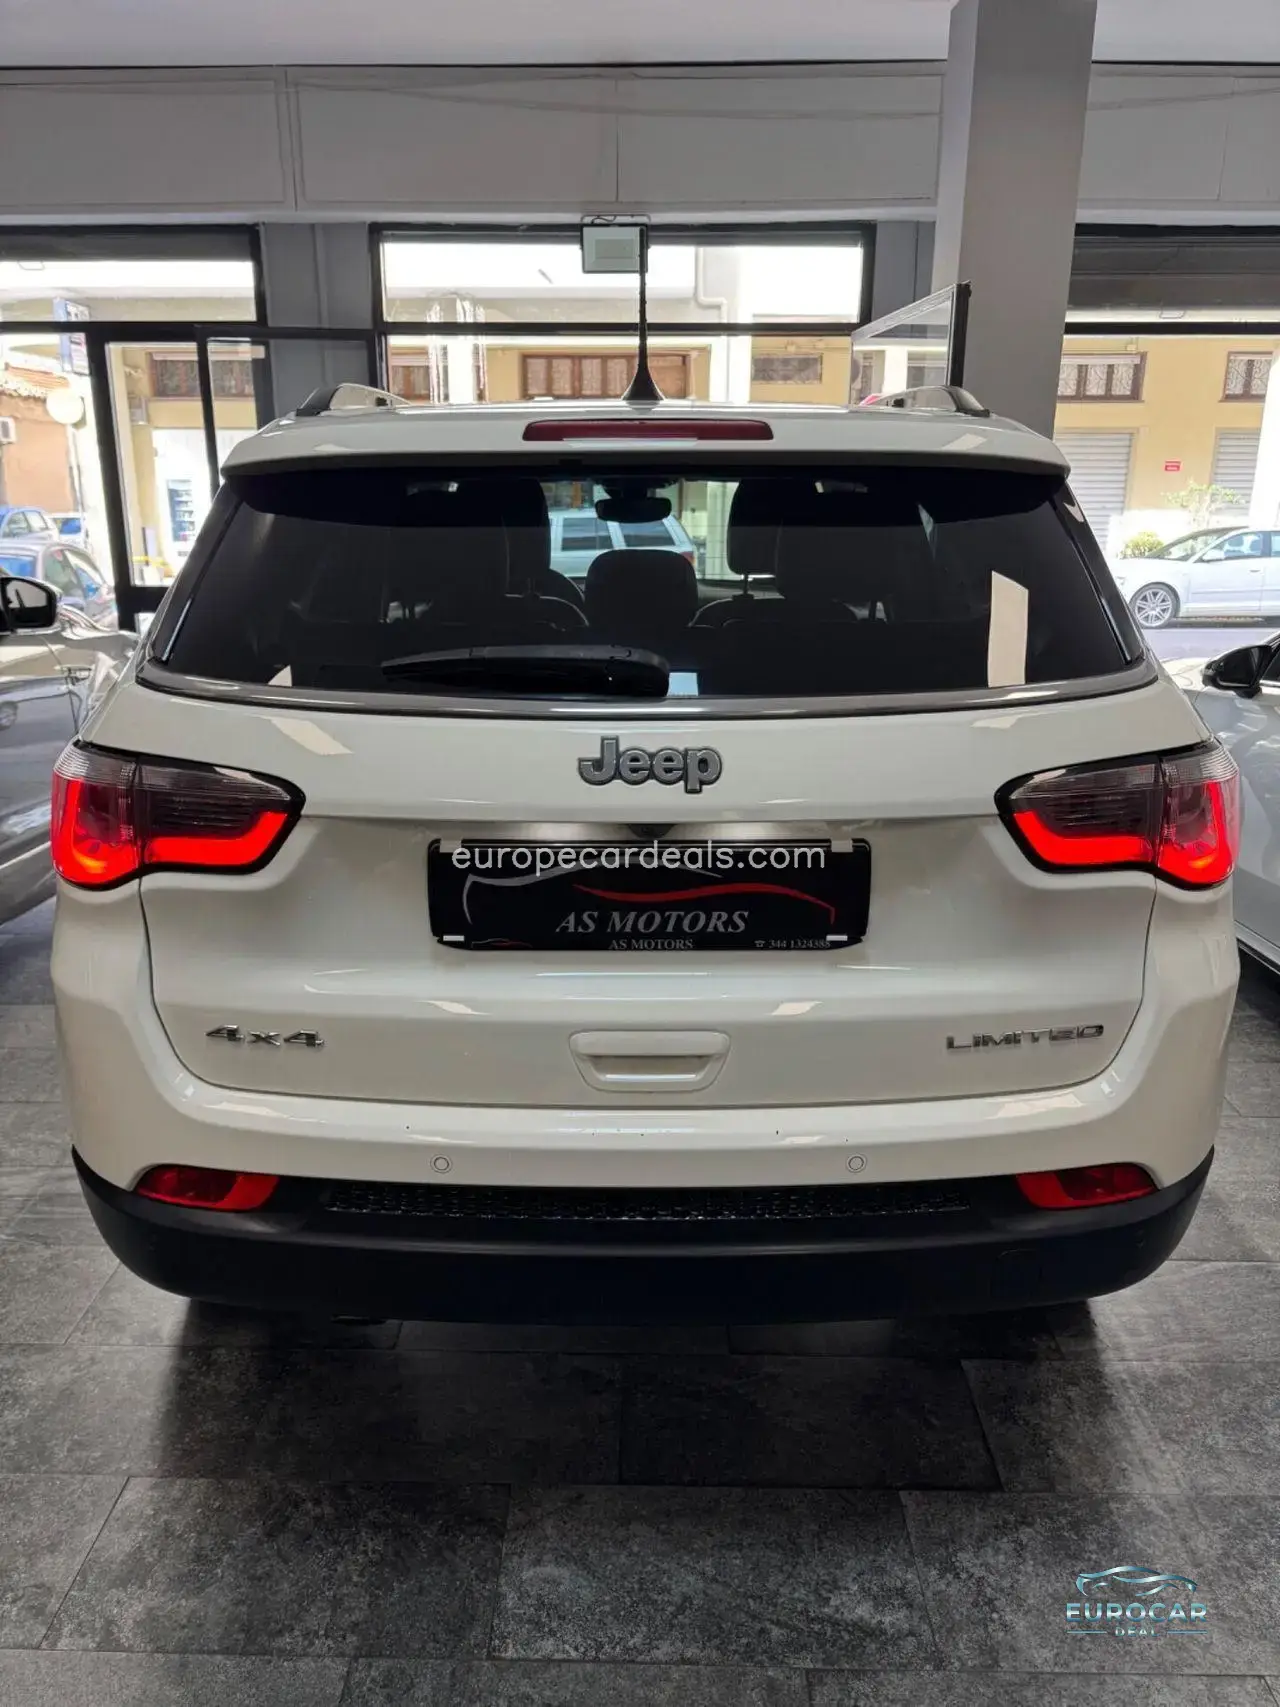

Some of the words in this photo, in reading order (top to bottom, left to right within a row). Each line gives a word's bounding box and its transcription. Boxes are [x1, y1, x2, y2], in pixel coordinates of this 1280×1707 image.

[578, 735, 723, 794] Jeep
[555, 911, 598, 933] AS
[606, 911, 749, 933] MOTORS
[608, 939, 628, 950] AS
[631, 939, 694, 950] MOTORS
[946, 1024, 1104, 1050] LIMITED
